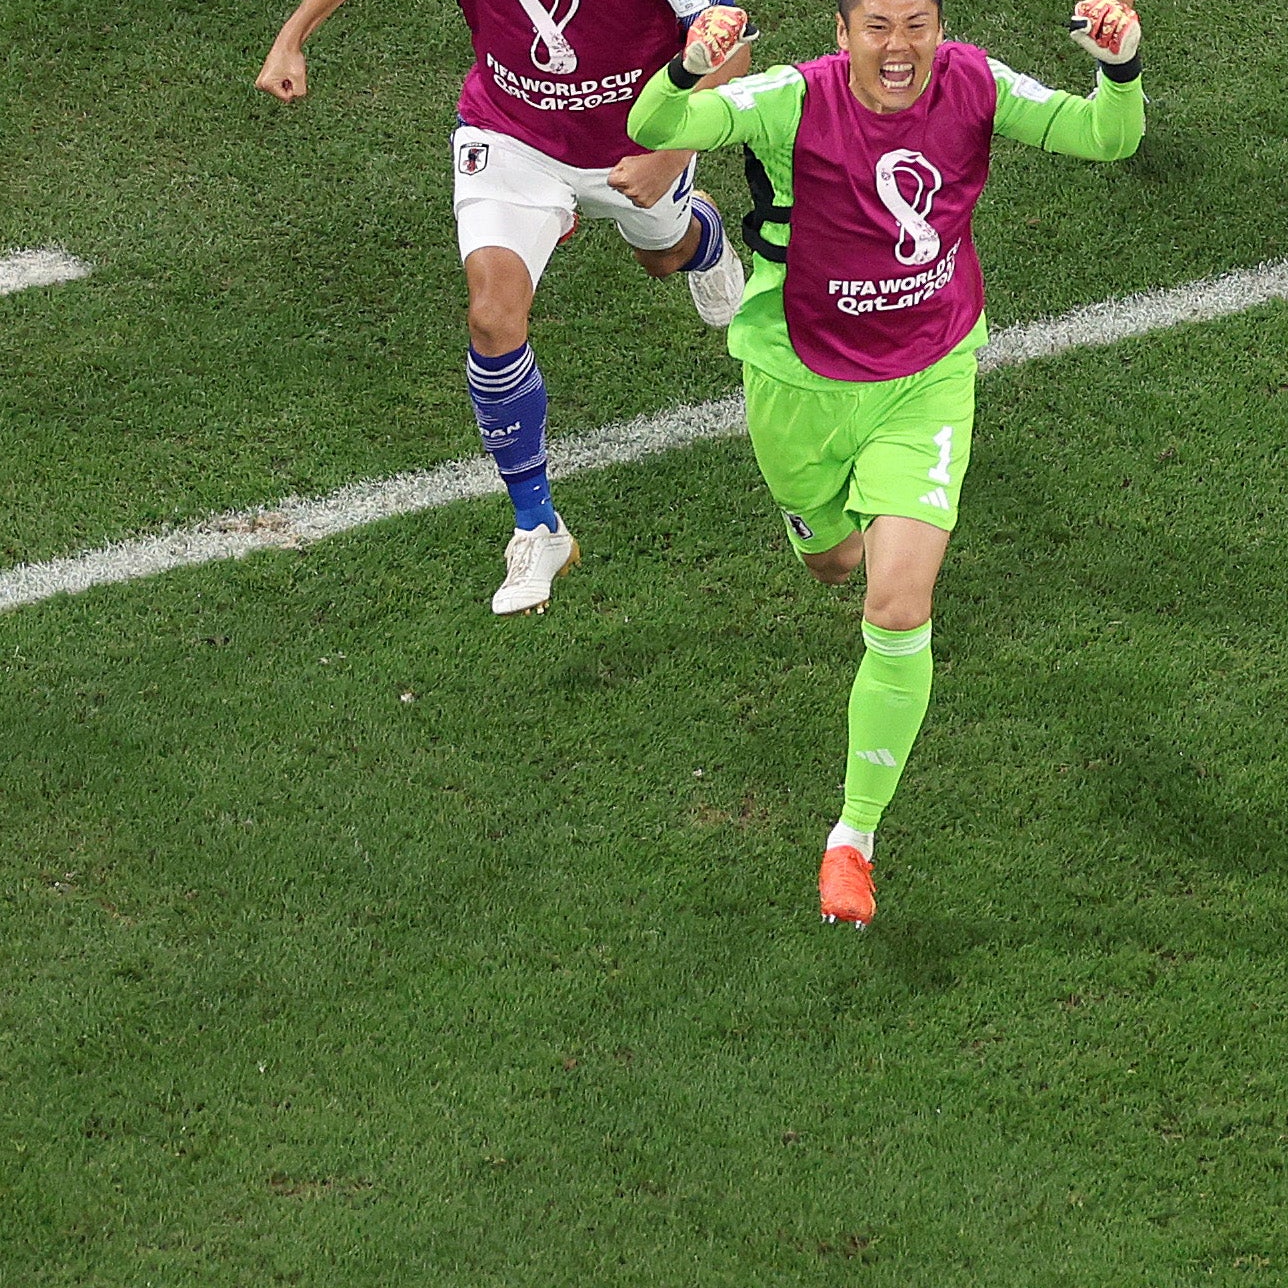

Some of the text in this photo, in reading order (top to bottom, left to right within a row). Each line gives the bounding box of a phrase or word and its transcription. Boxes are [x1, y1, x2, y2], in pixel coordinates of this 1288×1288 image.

[486, 53, 643, 97] FIFA WORLD CUP
[828, 258, 946, 296] FIFA WORLD
[927, 424, 955, 485] 1
